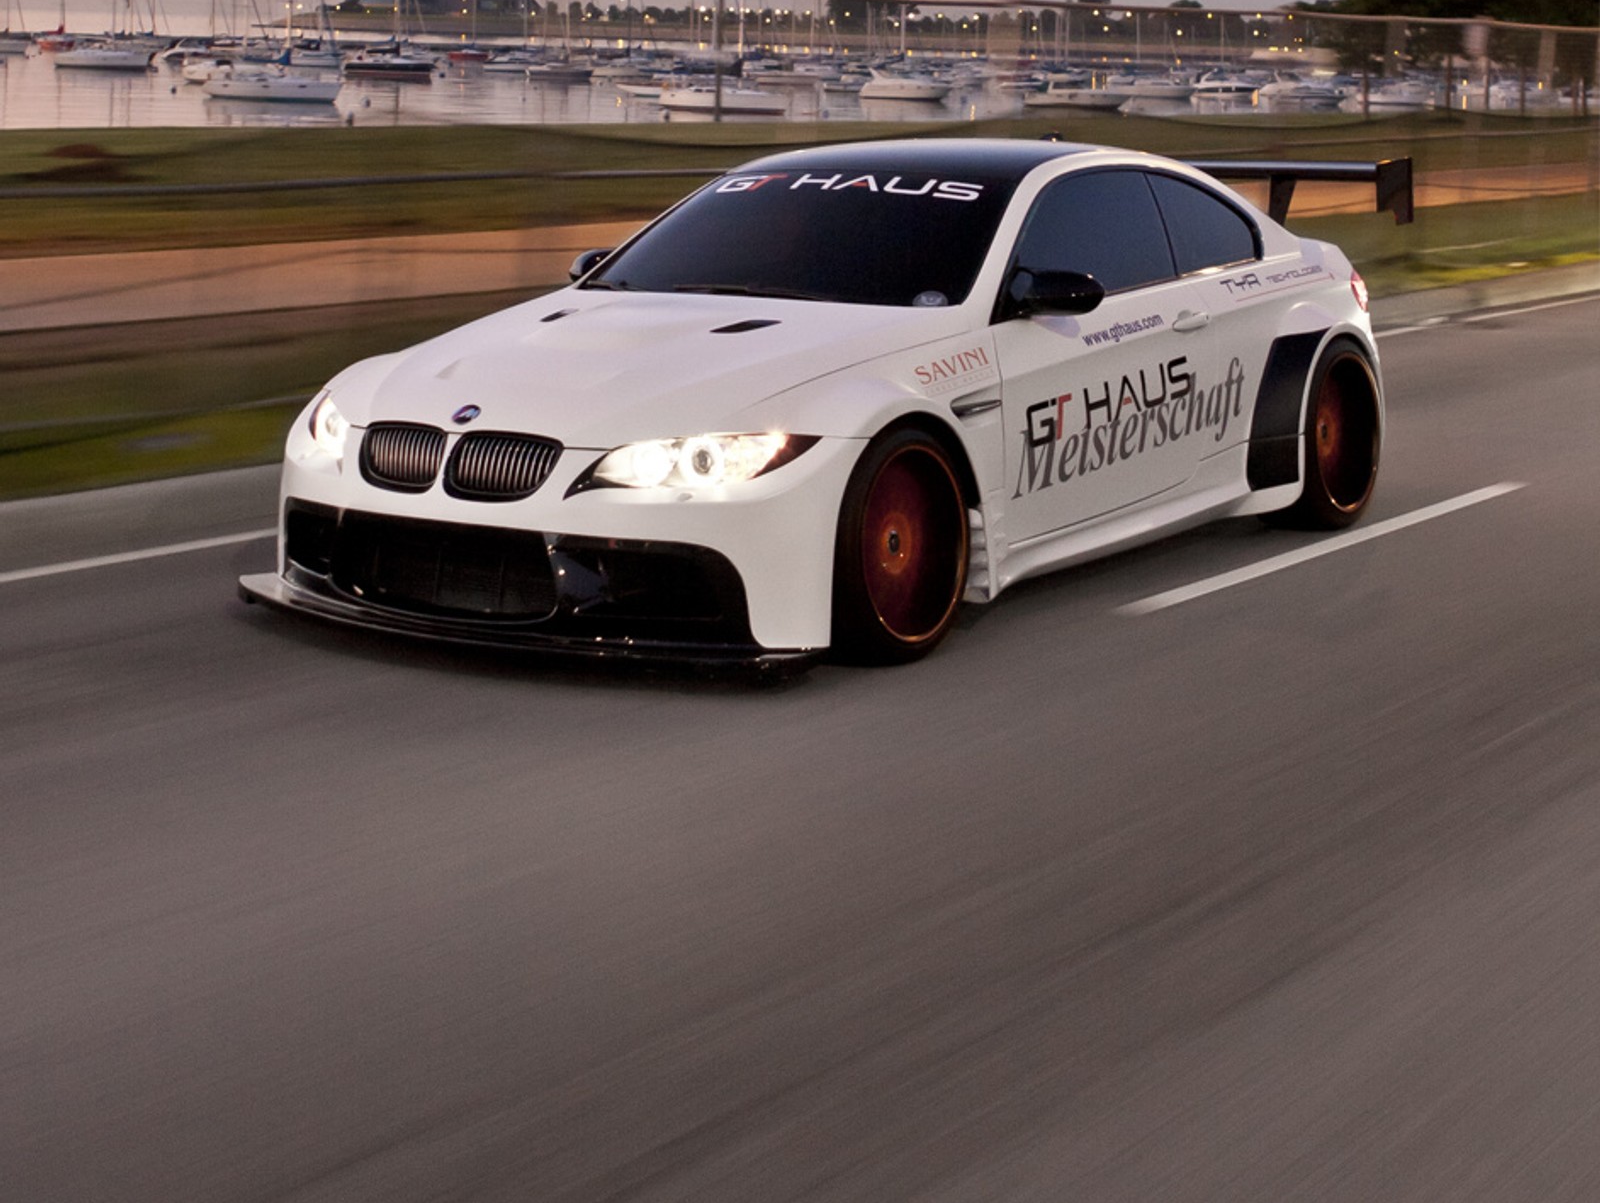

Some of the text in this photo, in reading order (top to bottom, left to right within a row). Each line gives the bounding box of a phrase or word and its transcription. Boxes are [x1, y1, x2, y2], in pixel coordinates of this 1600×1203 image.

[715, 173, 985, 201] GT HAUS
[1082, 314, 1164, 346] www.gthaus.com
[914, 347, 989, 385] SAVINI
[1026, 356, 1192, 448] GT HAUS
[1011, 357, 1245, 500] Meisterschaft
